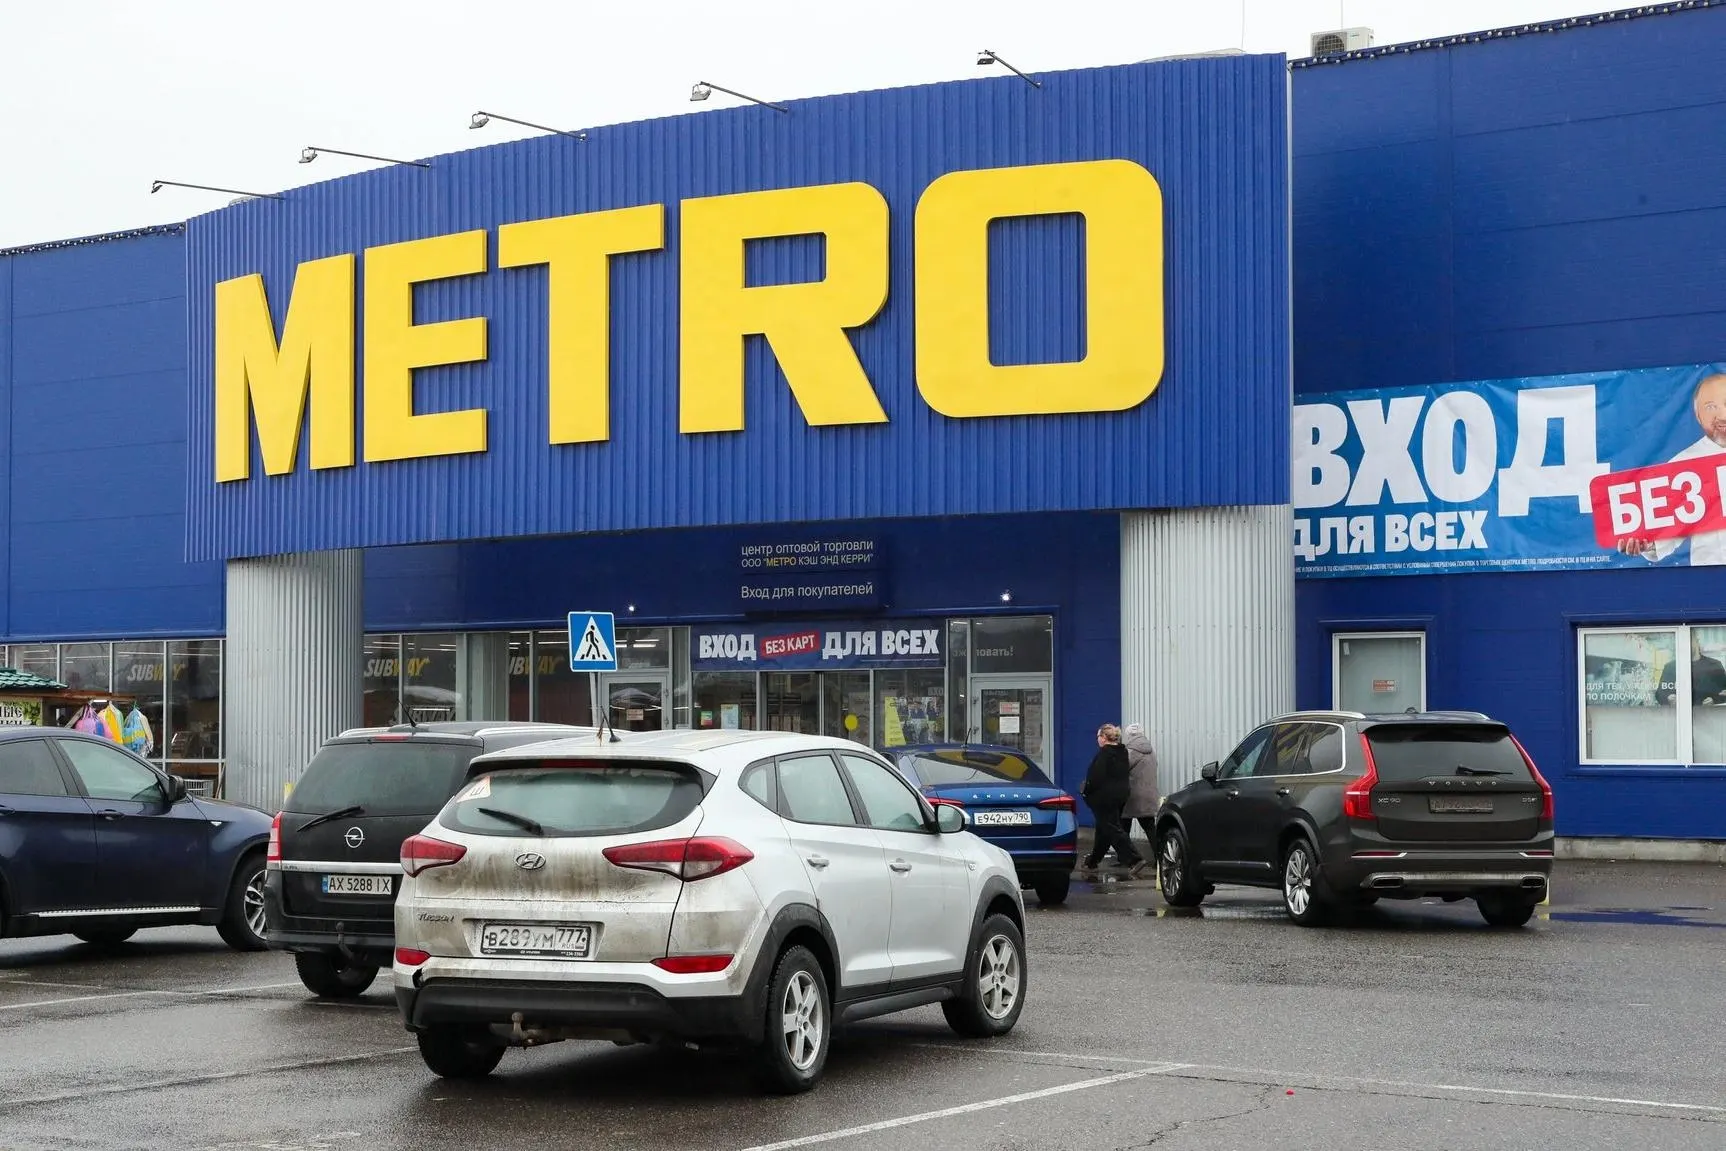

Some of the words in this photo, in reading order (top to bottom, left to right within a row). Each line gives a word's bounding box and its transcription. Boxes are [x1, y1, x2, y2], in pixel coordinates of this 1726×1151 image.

[215, 158, 1165, 482] METRO
[1294, 384, 1610, 517] ВХОД
[1607, 470, 1706, 536] БЕЗ
[1385, 510, 1488, 553] ВСЕХ
[741, 545, 773, 557] центр
[776, 541, 820, 554] оптовой
[824, 541, 873, 554] торговли
[741, 558, 761, 568] ООО
[798, 556, 818, 566] КЭШ
[820, 555, 839, 565] ЭНД
[741, 585, 769, 599] Вход
[772, 586, 794, 599] для
[798, 582, 873, 599] покупателей
[699, 634, 757, 661] ВХОД
[765, 639, 786, 655] БЕЗ
[787, 634, 815, 651] КАРТ
[822, 631, 876, 660] ДЛЯ
[882, 629, 940, 655] ВСЕХ
[127, 663, 187, 682] SUBWY
[328, 877, 344, 891] AX
[346, 878, 373, 892] 5288
[557, 928, 584, 943] 777
